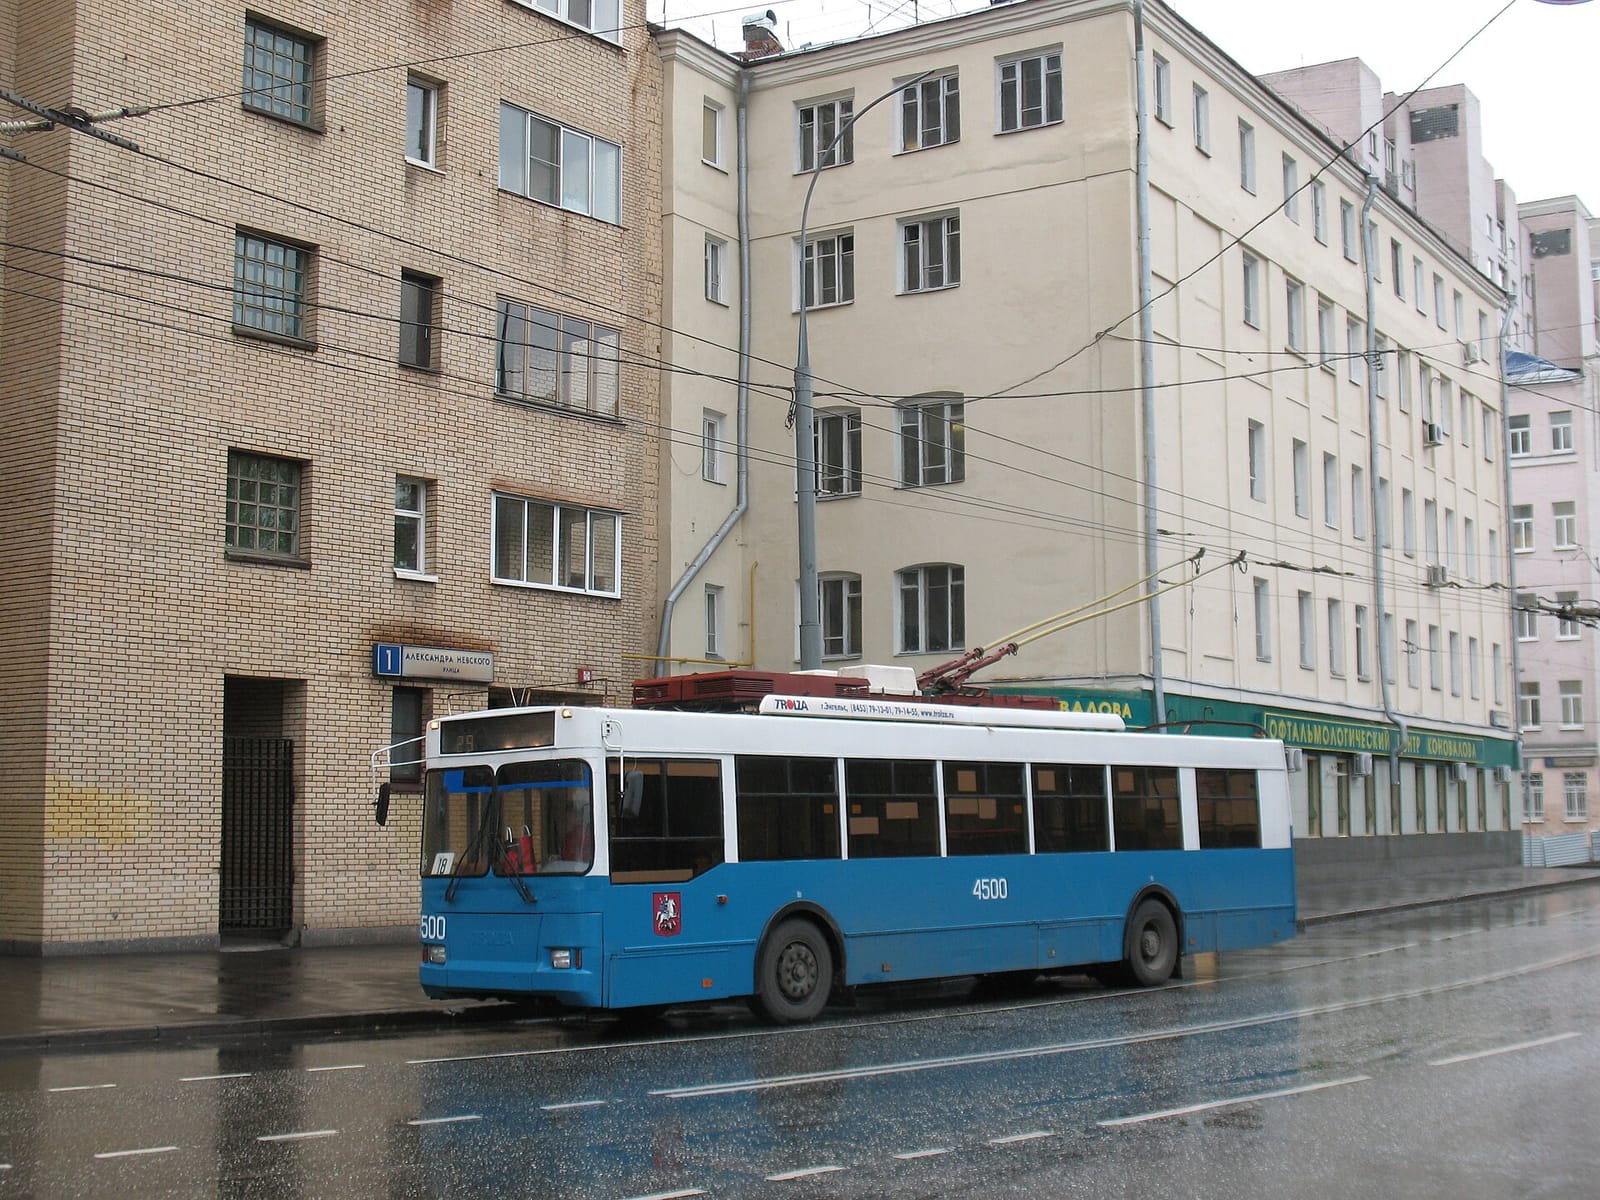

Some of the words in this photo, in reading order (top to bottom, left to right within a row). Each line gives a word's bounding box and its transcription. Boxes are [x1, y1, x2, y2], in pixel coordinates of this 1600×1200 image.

[386, 650, 392, 671] 1
[405, 652, 453, 663] АЛЕКСАНДРА
[457, 656, 491, 665] НЕВСКОГО
[1269, 719, 1391, 751] ОФТАЛЬМОЛОГИЧЕСКИЙ
[1397, 734, 1420, 754] НТР
[1427, 736, 1477, 758] КОНОВАЛОВА
[973, 878, 1008, 900] 4500
